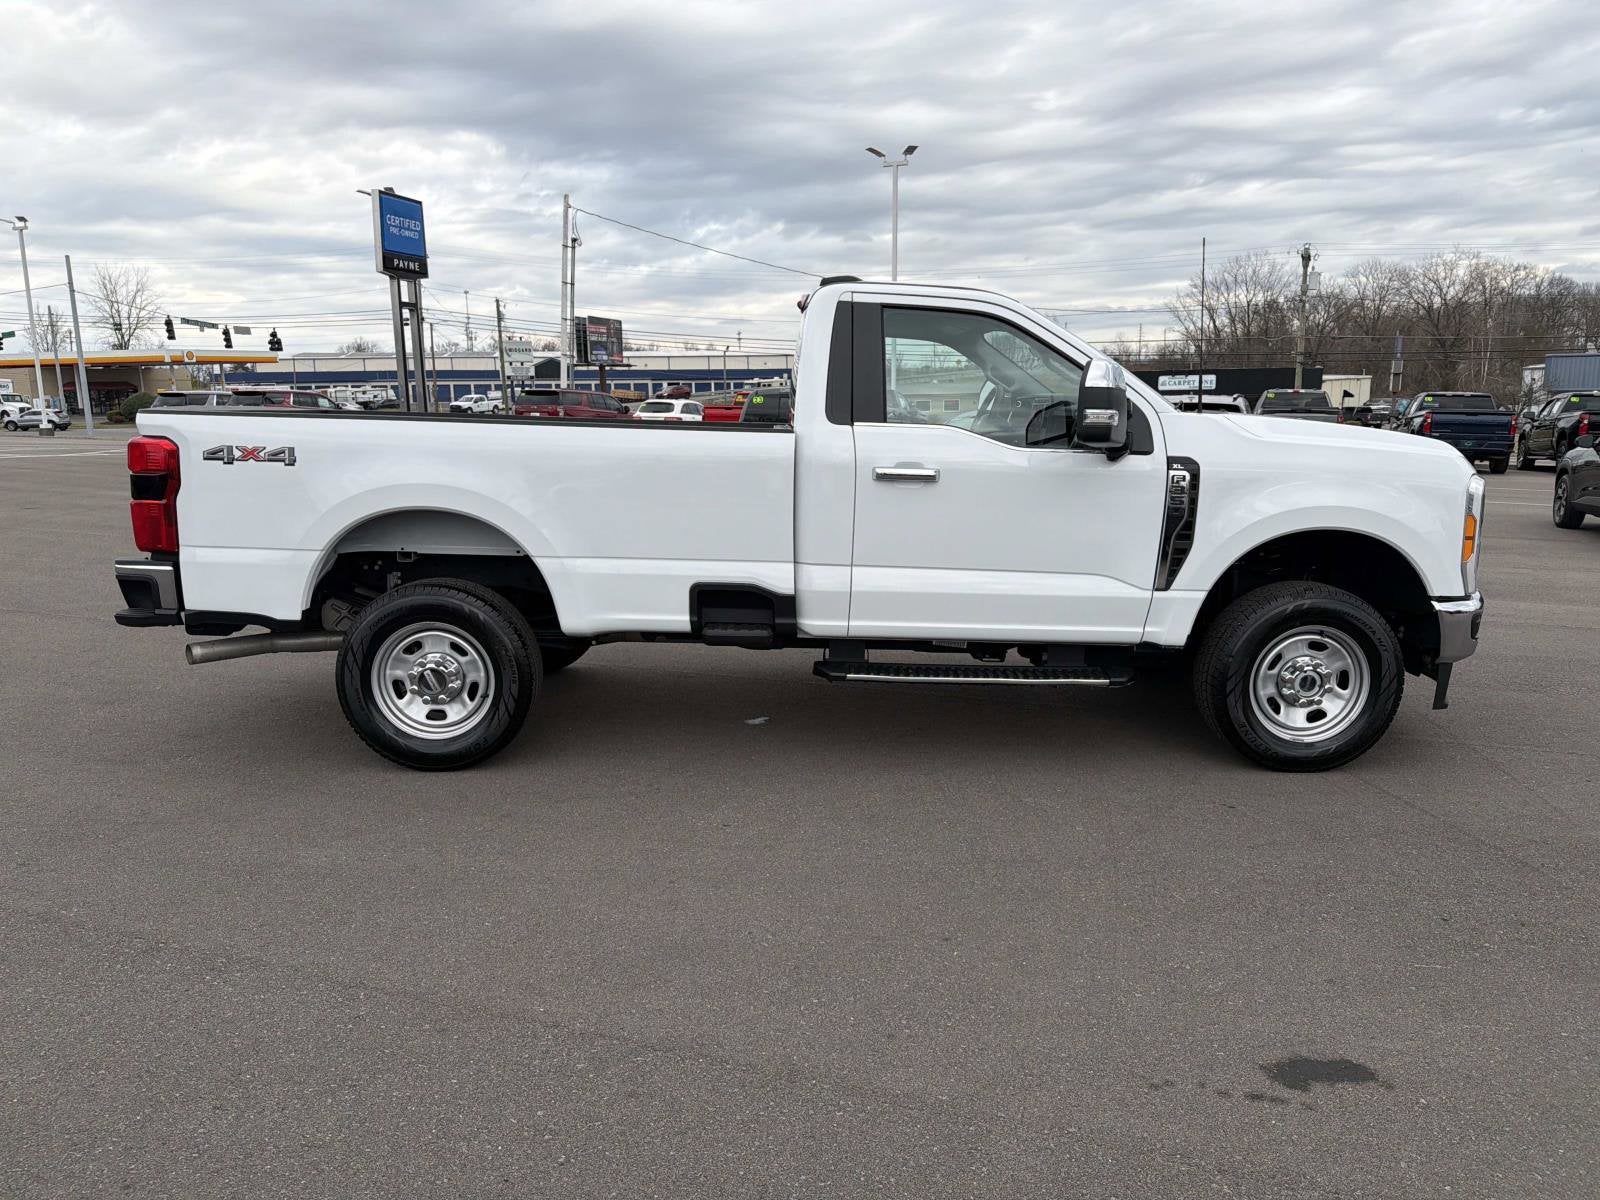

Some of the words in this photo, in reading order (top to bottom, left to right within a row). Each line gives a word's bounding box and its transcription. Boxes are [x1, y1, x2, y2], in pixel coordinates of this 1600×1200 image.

[386, 214, 421, 231] CERTIFIED
[389, 227, 419, 239] PRE-OWNED
[393, 258, 420, 271] PAYNE
